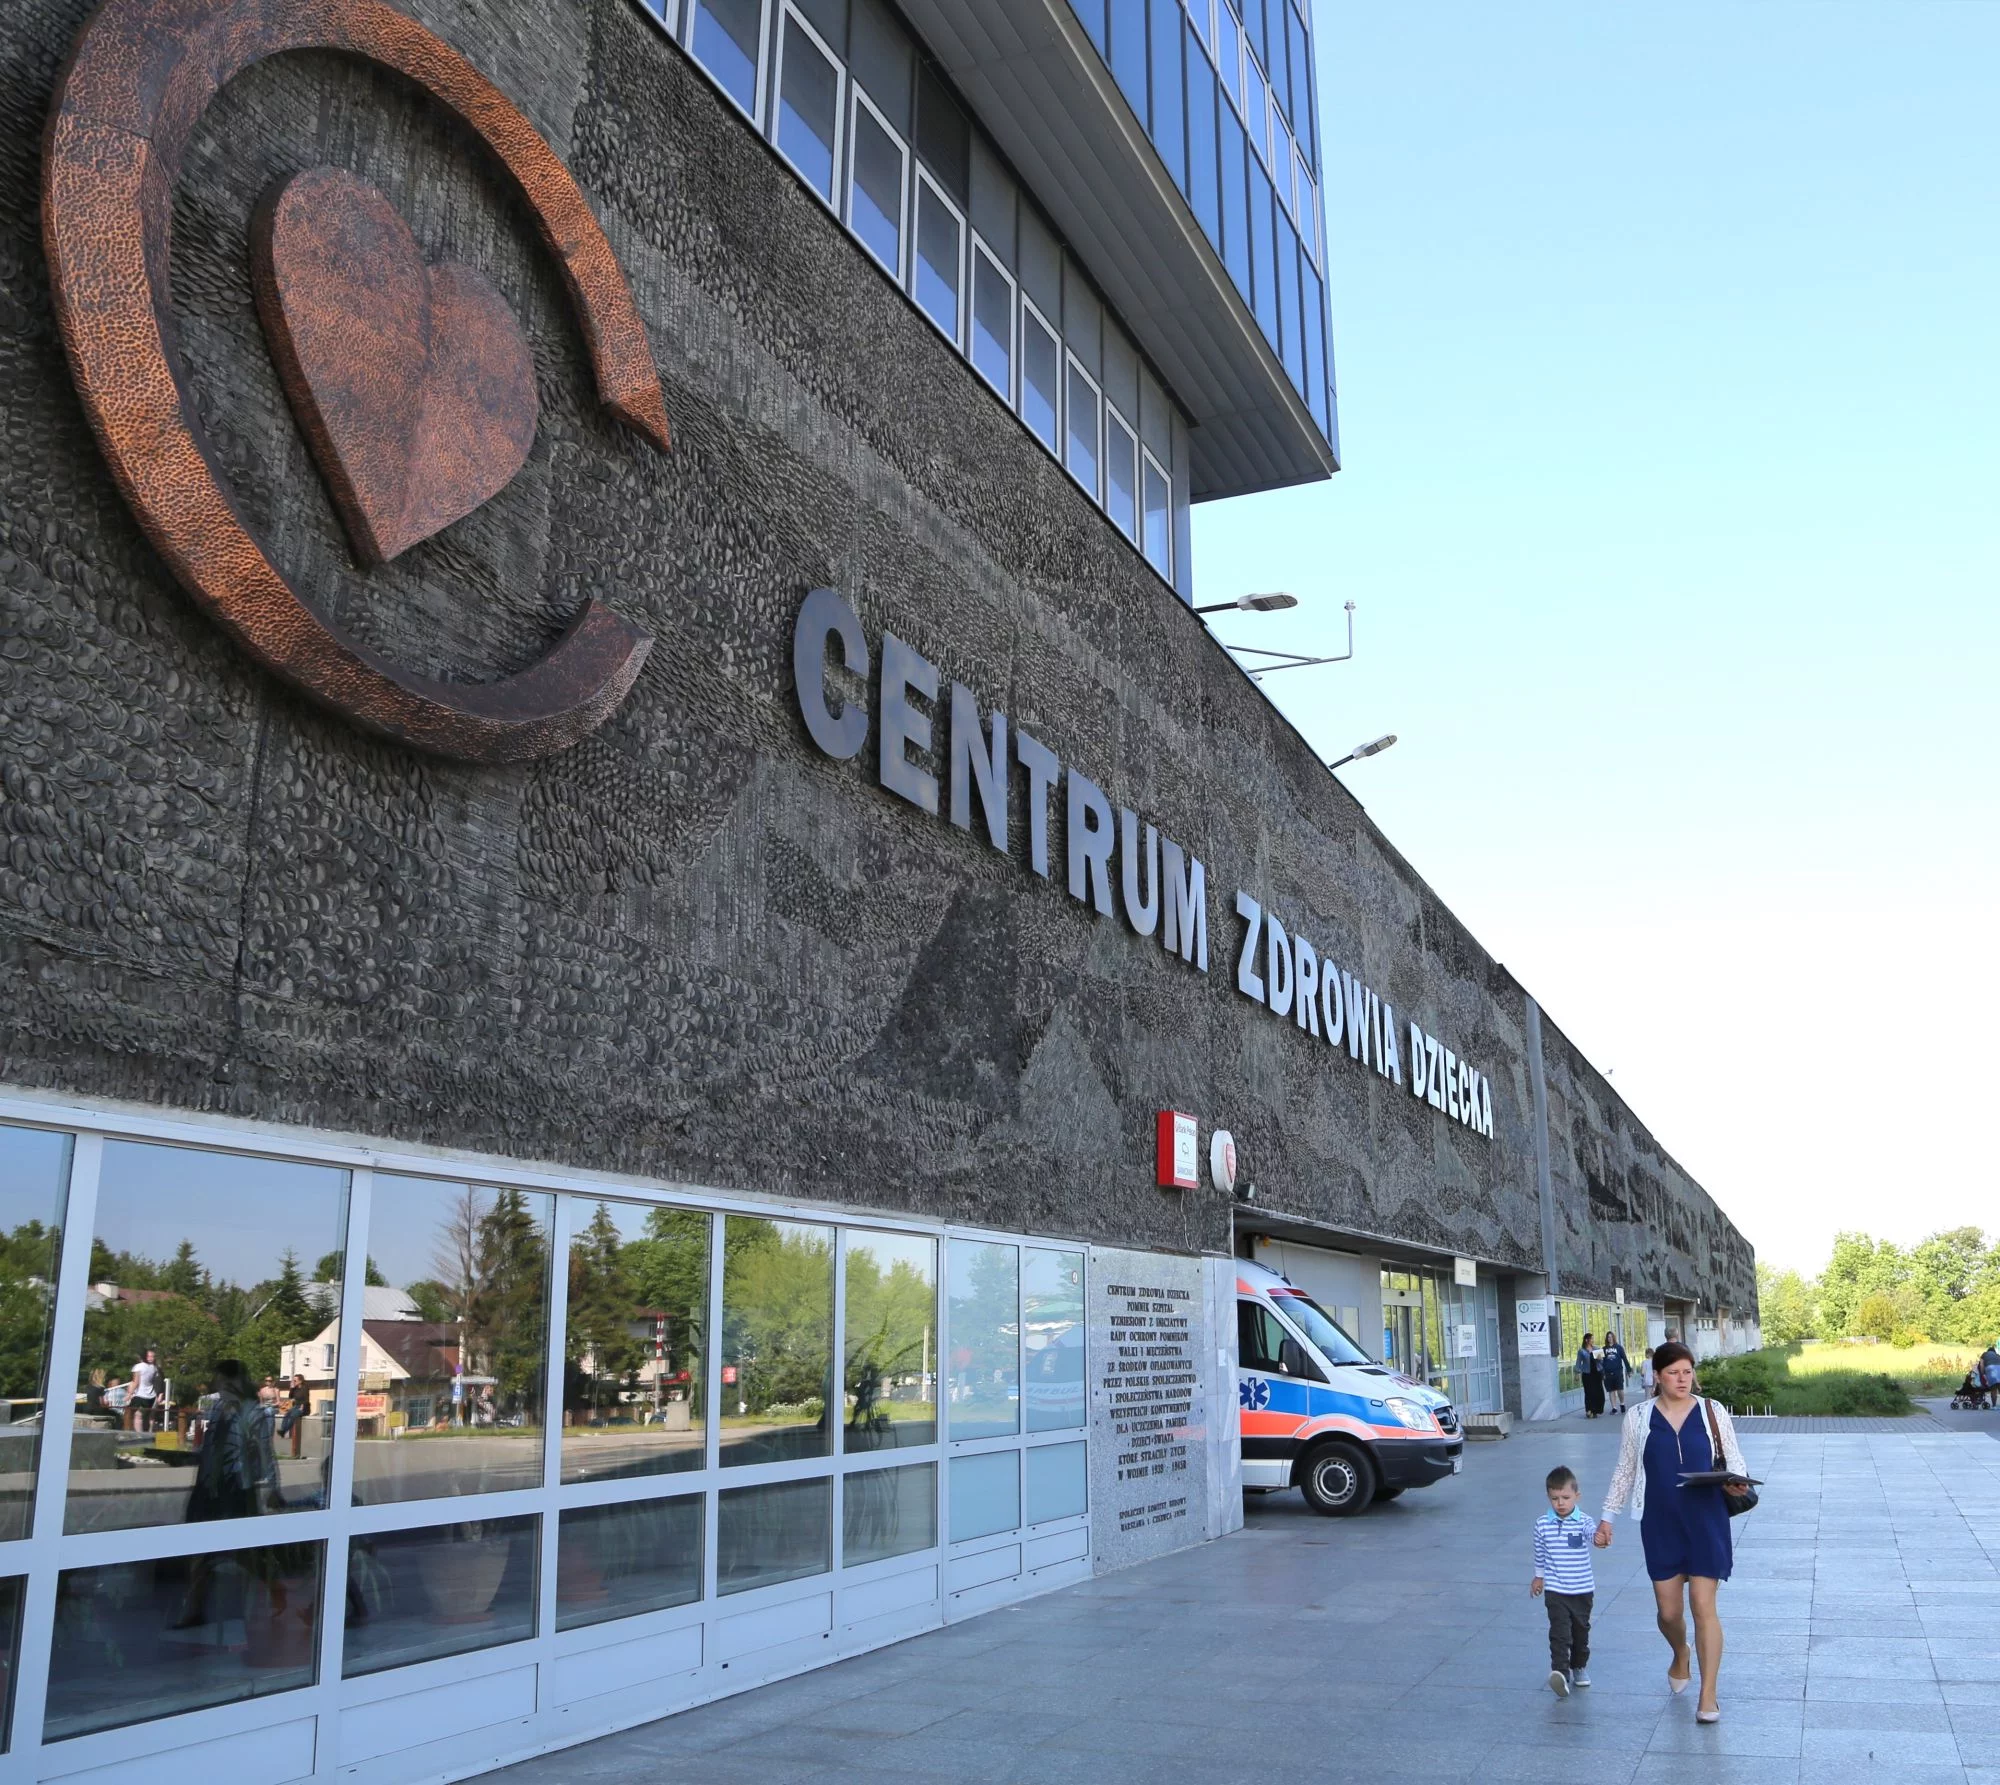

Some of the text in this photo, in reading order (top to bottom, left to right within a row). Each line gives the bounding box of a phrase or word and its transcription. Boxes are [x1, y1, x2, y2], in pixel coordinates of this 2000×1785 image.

[793, 588, 1494, 1140] CENTRUM ZDROWIA DZIECKA
[1107, 1285, 1190, 1300] CENTRUM ZDROWIA DZIECKA
[1127, 1302, 1174, 1313] POMNIK SZPITAL
[1110, 1316, 1188, 1327] WZNIESIONY Z INICJATYWY
[1520, 1321, 1547, 1332] NFZ
[1110, 1331, 1189, 1341] RADY OCHRONY POMNIKÓW
[1119, 1347, 1138, 1357] WALKI
[1140, 1347, 1144, 1357] I
[1107, 1362, 1115, 1372] ZE
[1150, 1360, 1192, 1370] OFIAROWANYCH
[1103, 1377, 1122, 1388] PRZEZ
[1125, 1376, 1149, 1387] POLSKIE
[1109, 1393, 1112, 1404] I
[1165, 1387, 1192, 1398] NARODÓW
[1110, 1406, 1148, 1419] WSZYSTKICH
[1116, 1423, 1128, 1434] DLA
[1131, 1420, 1163, 1432] UCZCZENIA
[1131, 1436, 1150, 1448] DZIECI
[1118, 1453, 1138, 1465] KTÓRE
[1118, 1470, 1124, 1481] W
[1127, 1466, 1148, 1479] WOJNIE
